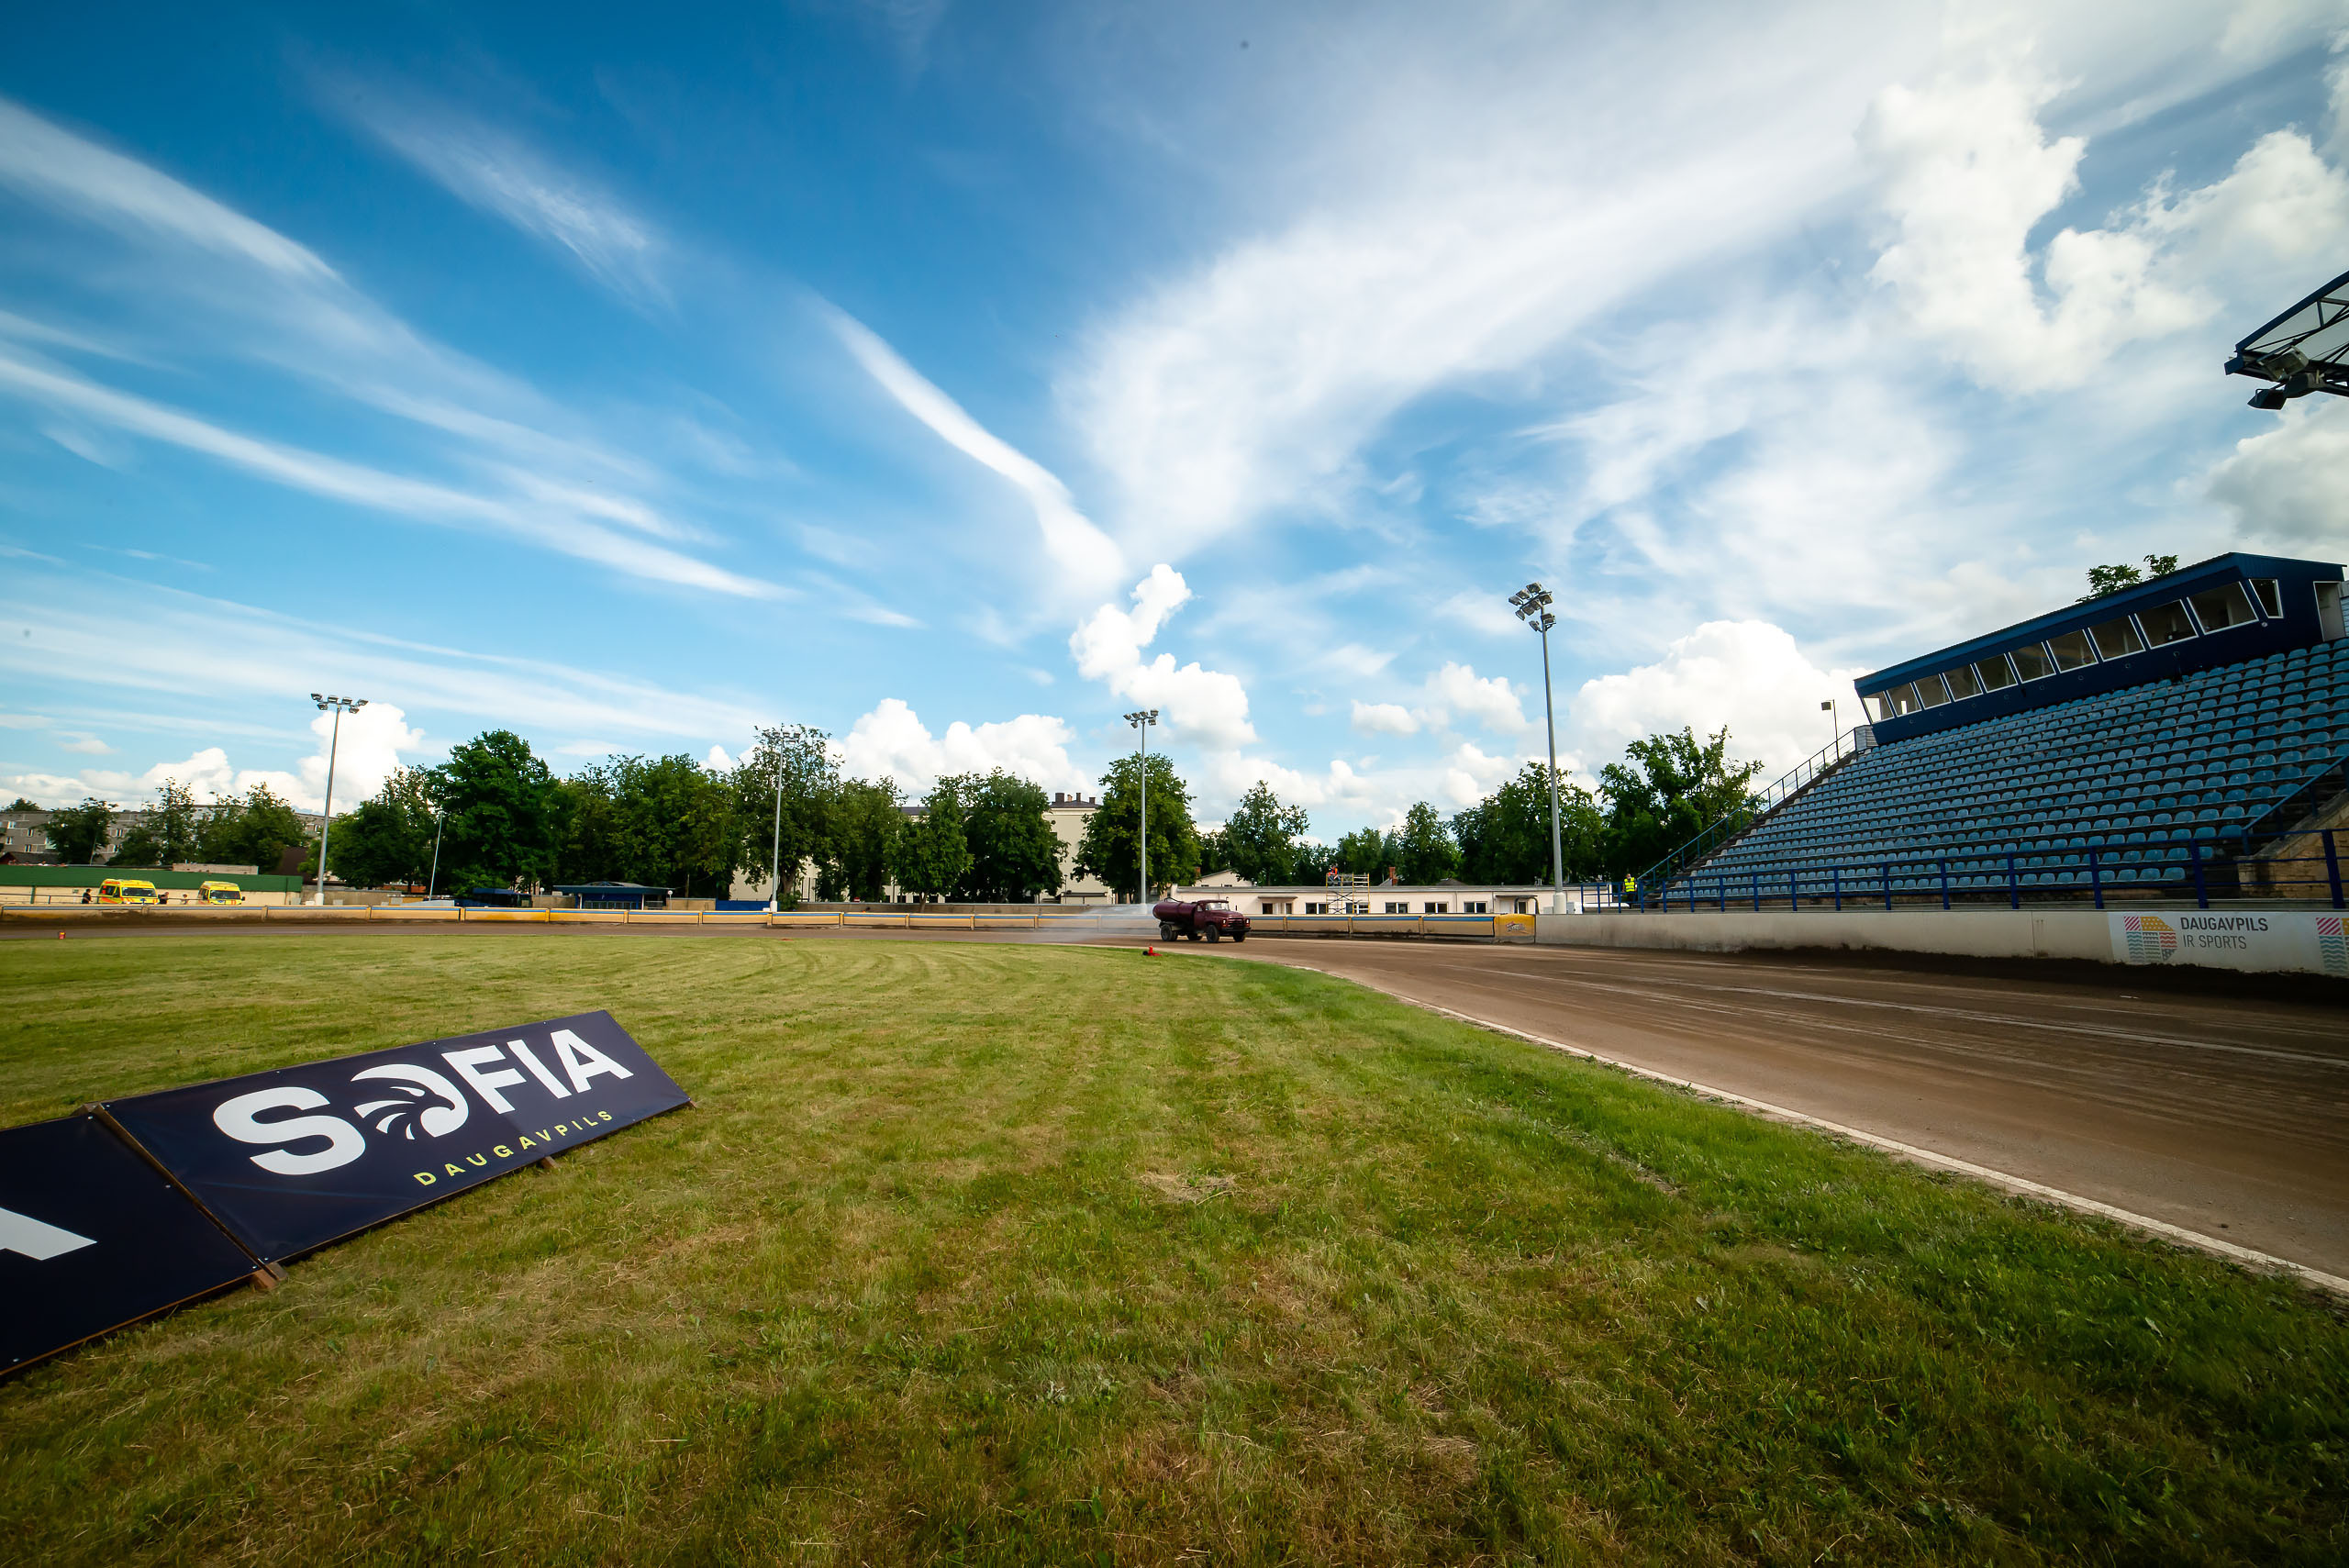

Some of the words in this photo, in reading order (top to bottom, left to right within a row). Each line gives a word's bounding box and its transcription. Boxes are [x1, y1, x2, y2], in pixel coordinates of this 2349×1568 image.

[2180, 917, 2269, 931] DAUGAVPILS
[2183, 935, 2195, 947] IR
[2199, 935, 2247, 950] SPORTS
[213, 1029, 634, 1175] SOFIA
[413, 1109, 614, 1186] DAUGAVPILS
